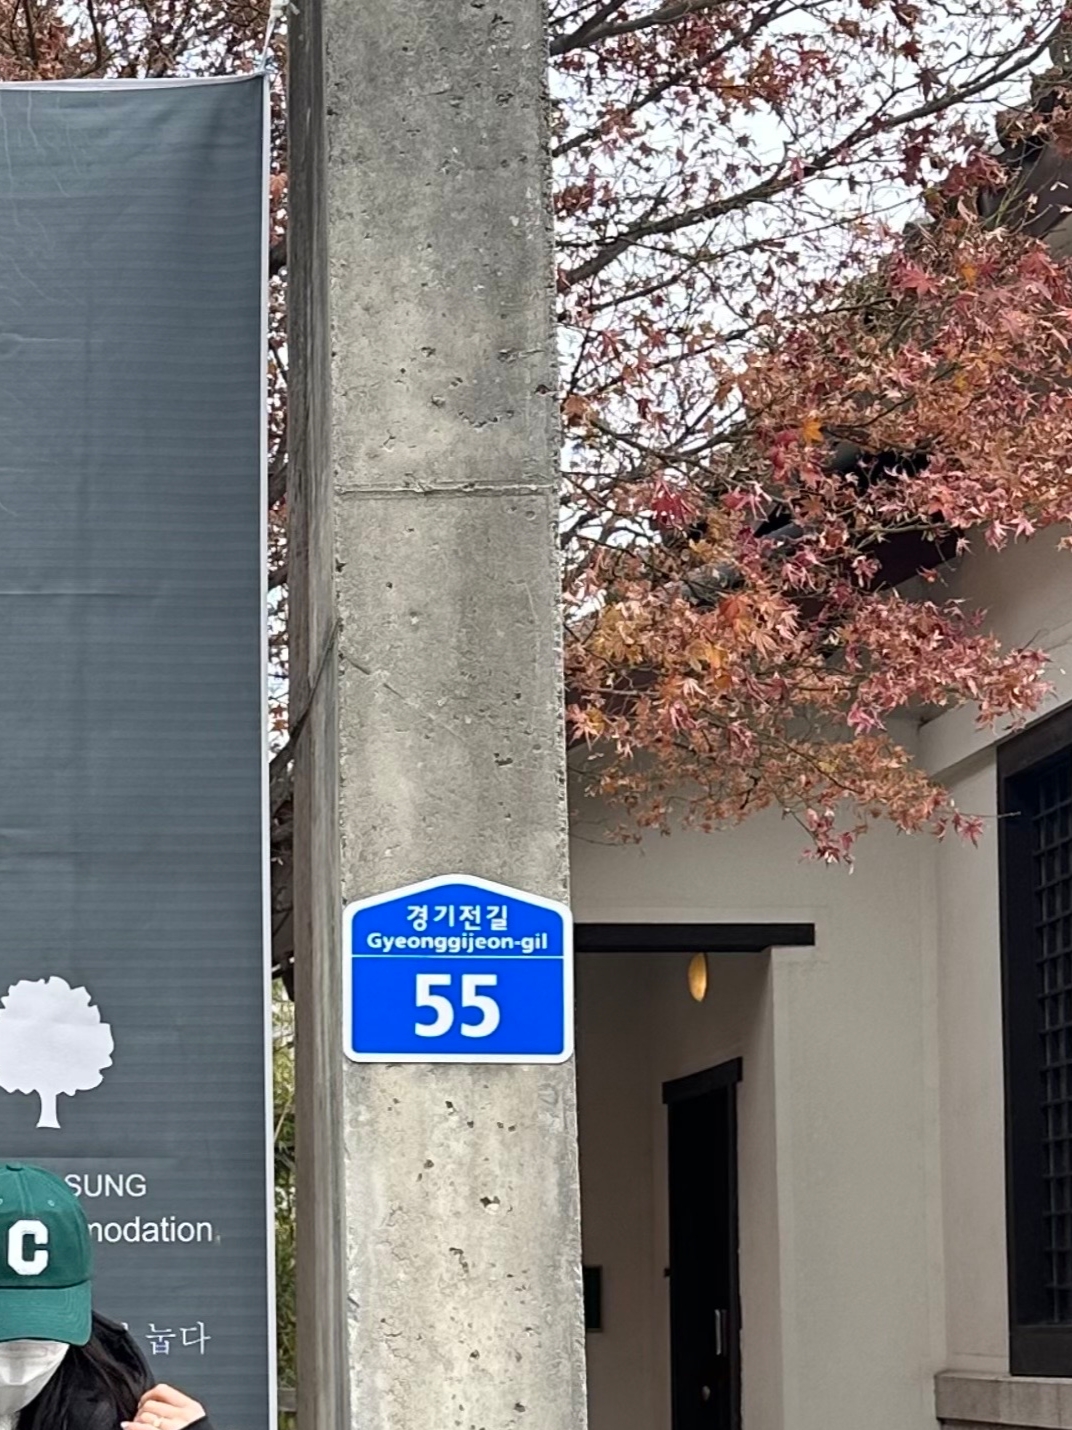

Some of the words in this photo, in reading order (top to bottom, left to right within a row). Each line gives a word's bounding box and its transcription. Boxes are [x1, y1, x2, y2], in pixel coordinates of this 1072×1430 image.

[406, 905, 508, 931] 경기전길
[367, 933, 548, 953] Gyeonggijeon-gil
[414, 974, 501, 1038] 55
[8, 1219, 49, 1275] C
[145, 1321, 211, 1355] 눕다
